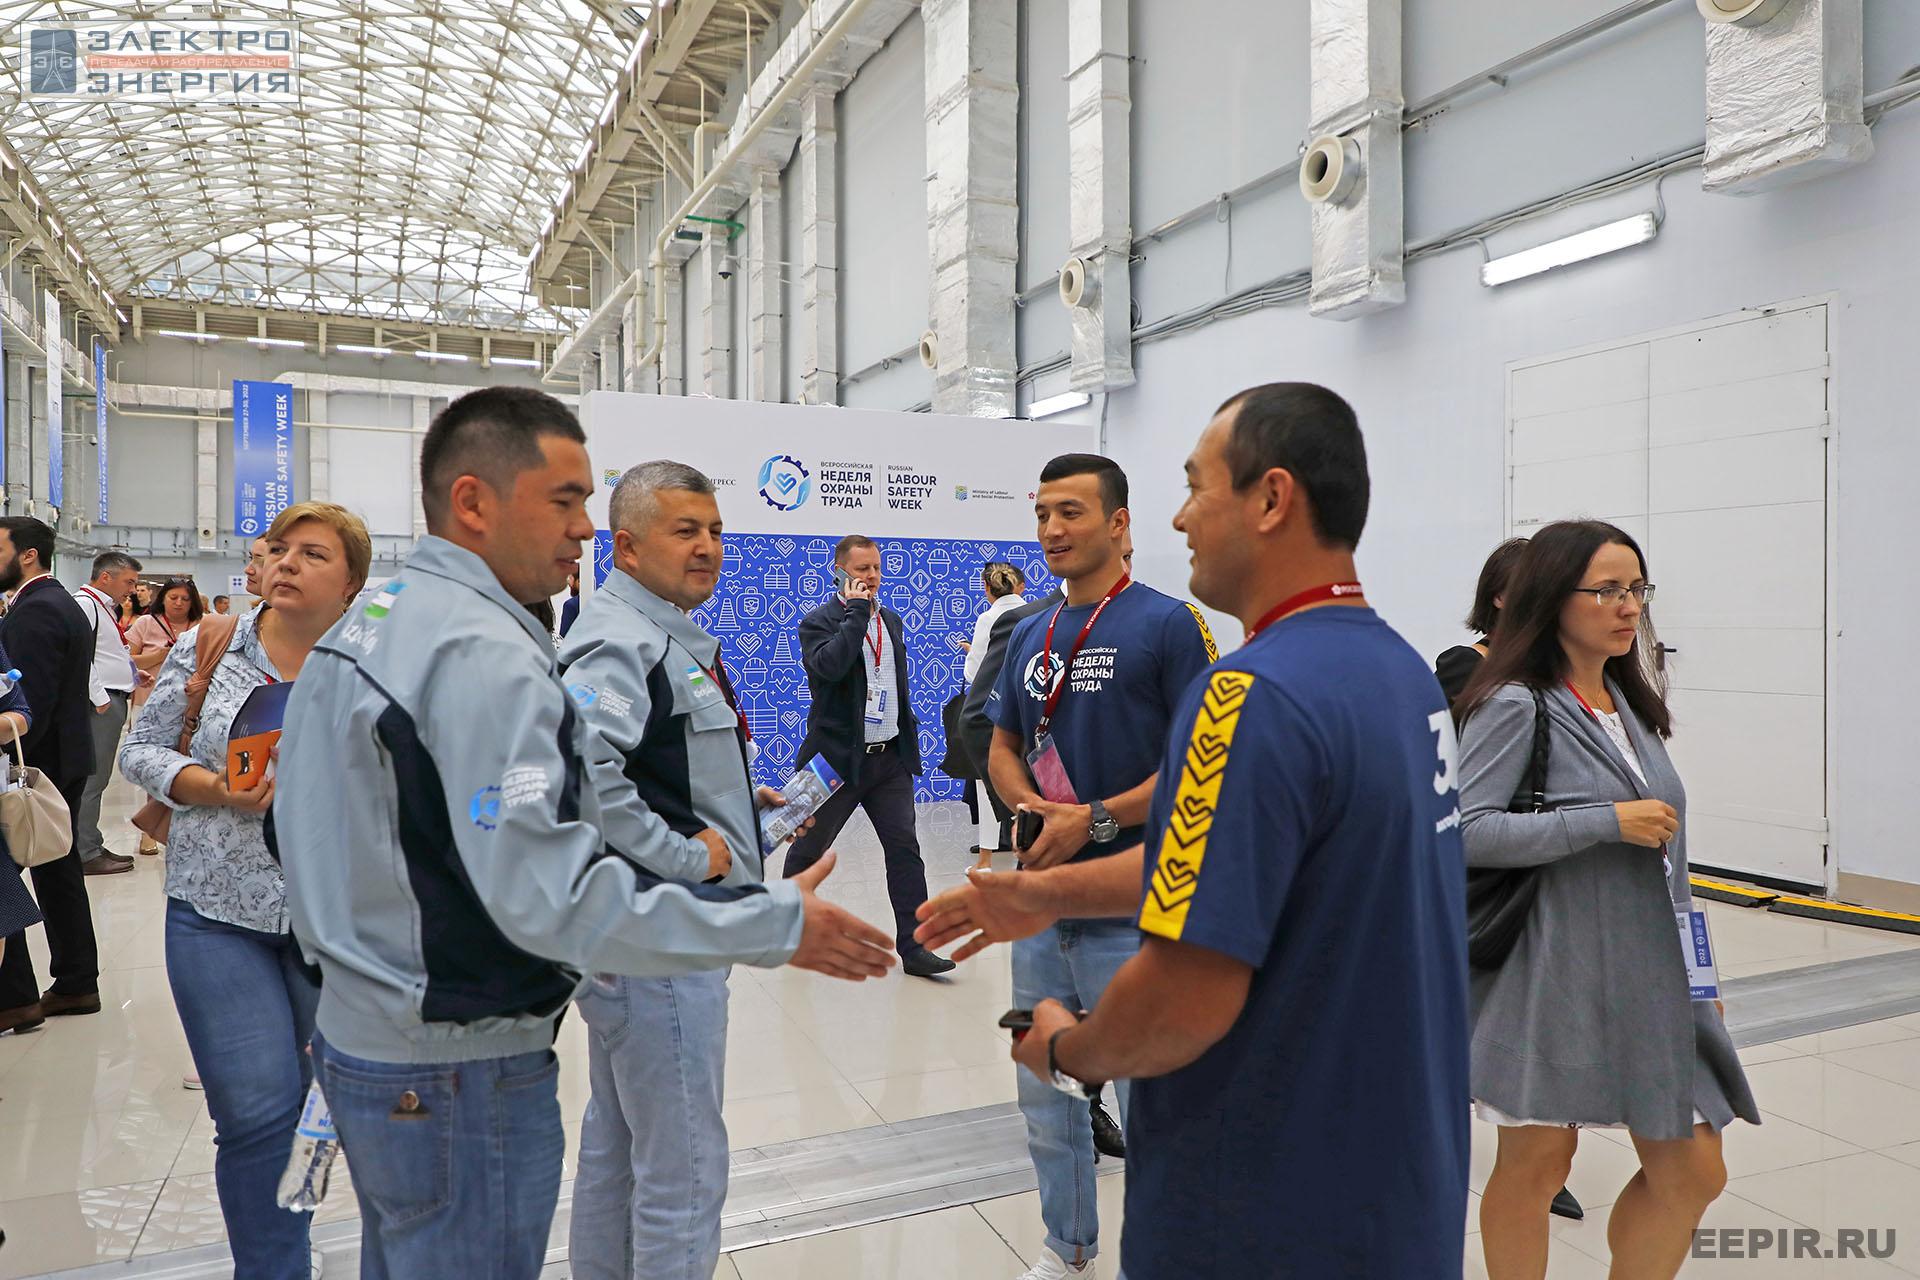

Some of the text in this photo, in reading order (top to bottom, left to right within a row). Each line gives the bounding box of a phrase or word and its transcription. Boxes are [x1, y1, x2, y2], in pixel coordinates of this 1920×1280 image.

[276, 394, 287, 431] WEEK
[276, 434, 288, 481] SAFETY
[820, 461, 873, 470] ВСЕРОССИЙСКАЯ
[820, 470, 871, 483] НЕДЕЛЯ
[888, 473, 937, 486] LABOUR
[820, 483, 873, 495] ОХРАНЫ
[888, 486, 932, 498] SAFETY
[821, 496, 862, 509] ТРУДА
[888, 499, 922, 510] WEEK
[1077, 646, 1118, 656] СЕРОССИЙСКАЯ
[1072, 655, 1114, 669] НЕДЕЛЯ
[1071, 668, 1114, 680] ОХРАНЫ
[1070, 680, 1102, 692] ТРУДА
[1698, 948, 1706, 965] 2022
